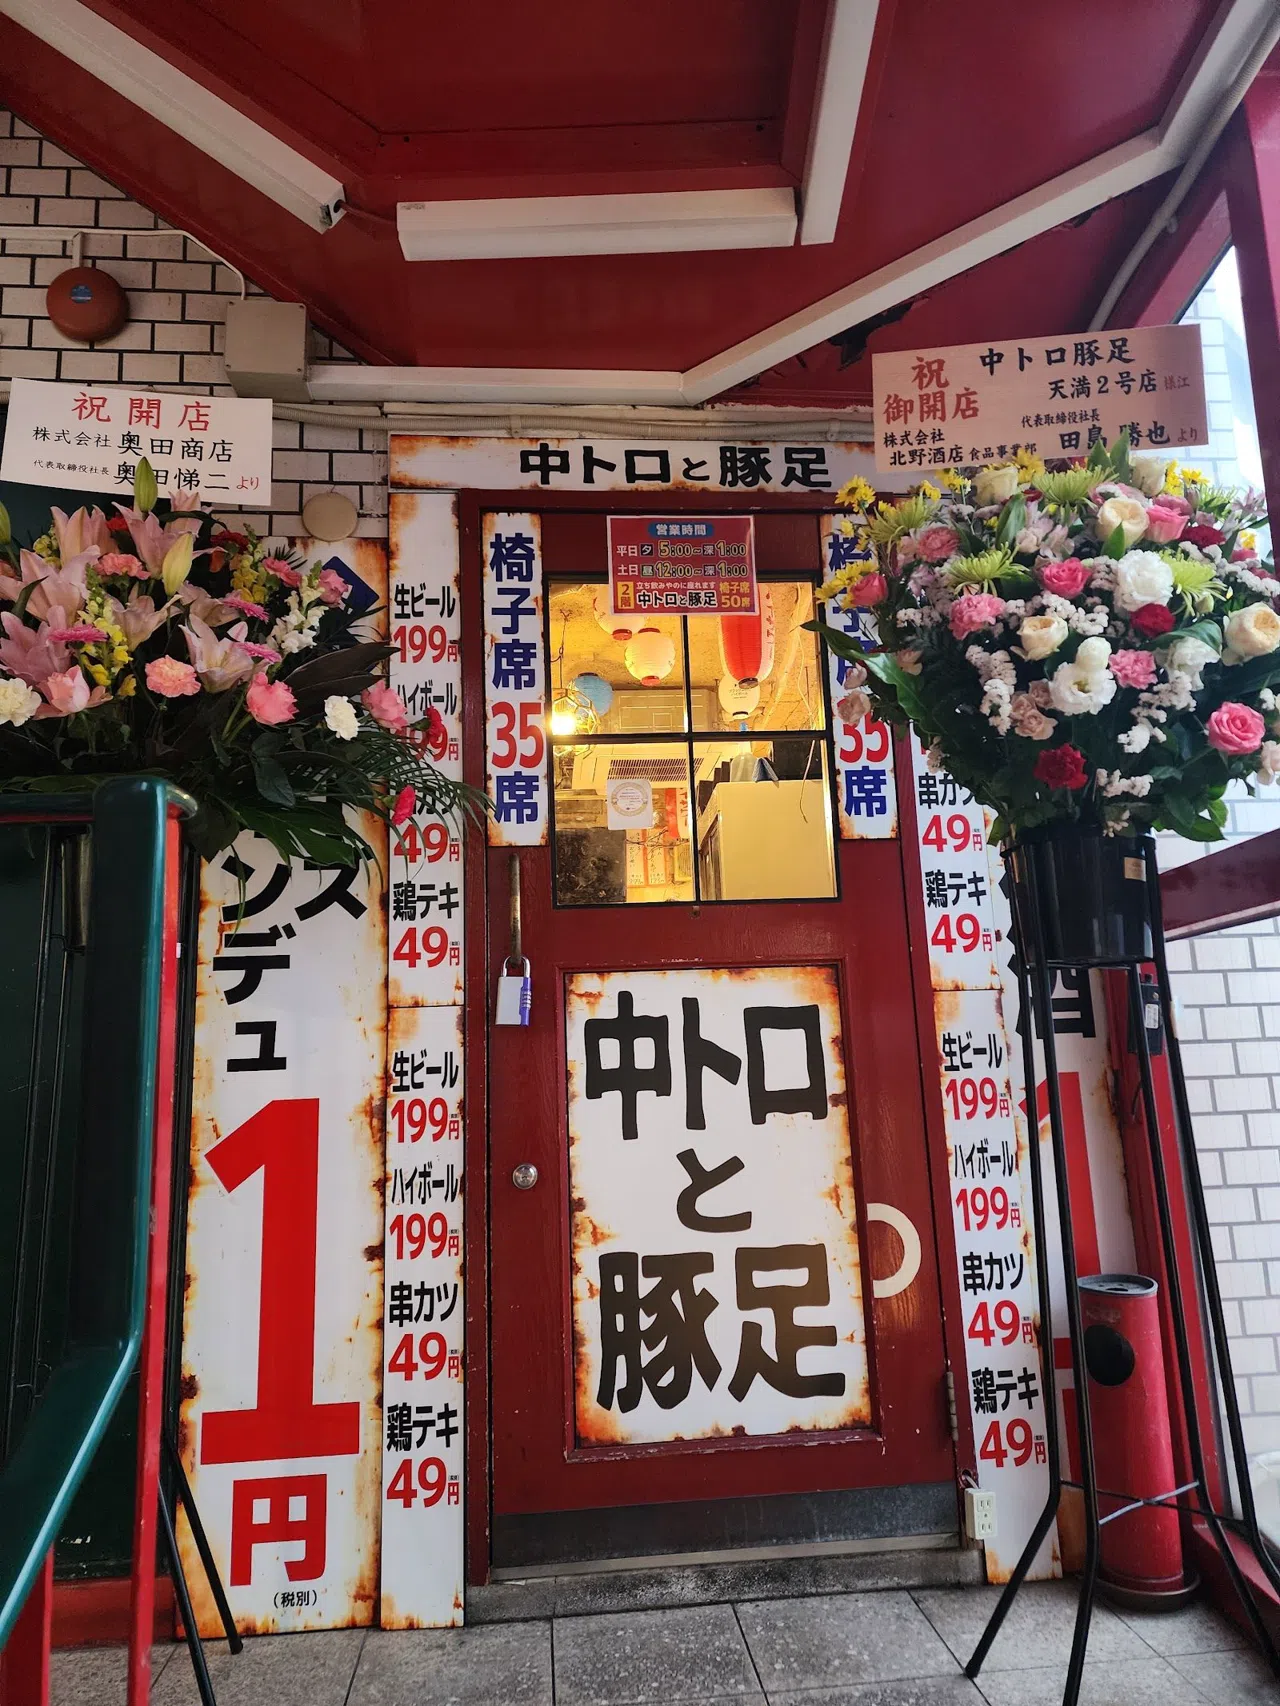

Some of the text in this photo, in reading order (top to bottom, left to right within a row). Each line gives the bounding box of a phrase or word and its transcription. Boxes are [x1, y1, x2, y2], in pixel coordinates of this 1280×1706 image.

[911, 356, 949, 391] 祝
[979, 337, 1136, 376] 中トロ豚足
[1048, 369, 1157, 400] 天満2号店
[71, 391, 212, 432] 祝開店
[883, 387, 979, 425] 御開店
[1021, 408, 1100, 429] 代表取締役社長
[32, 426, 234, 463] 株式会社 奥田商店
[883, 428, 945, 448] 株式会社
[890, 444, 963, 466] 北野酒店
[1177, 427, 1198, 443] より
[33, 459, 110, 476] 代表取締役社長
[236, 476, 260, 491] より
[519, 442, 832, 489] 中トロと豚足
[656, 524, 707, 536] 営業時間
[394, 582, 456, 619] 生ビール
[637, 591, 717, 608] 中トロと豚足
[719, 581, 750, 594] 椅子席
[721, 595, 751, 608] 50席
[393, 625, 459, 663] 199円
[397, 679, 458, 716] ハイボール
[393, 823, 460, 864] 49円
[921, 813, 983, 853] 49円
[393, 880, 460, 922] 鶏テキ
[924, 869, 987, 909] 鶏テキ
[393, 926, 460, 968] 49円
[931, 913, 993, 953] 49円
[392, 1049, 459, 1093] 生ビール
[584, 990, 828, 1141] 中トロ
[942, 1030, 1003, 1072] 生ビール
[945, 1077, 1010, 1121] 199円
[391, 1097, 460, 1144] 199円
[954, 1138, 1014, 1180] ハイボール
[391, 1161, 459, 1205] ハイボール
[676, 1147, 753, 1233] と
[955, 1185, 1021, 1232] 199円
[389, 1211, 460, 1260] 199円
[962, 1251, 1024, 1295] 串カツ
[389, 1280, 458, 1328] 串カツ
[967, 1300, 1033, 1347] 49円
[596, 1243, 846, 1414] 豚足
[388, 1331, 460, 1382] 49円
[971, 1366, 1039, 1415] 鶏テキ
[387, 1402, 459, 1452] 鶏テキ
[979, 1418, 1047, 1468] 49円
[386, 1456, 460, 1509] 49円
[273, 1589, 318, 1608] (税別)
